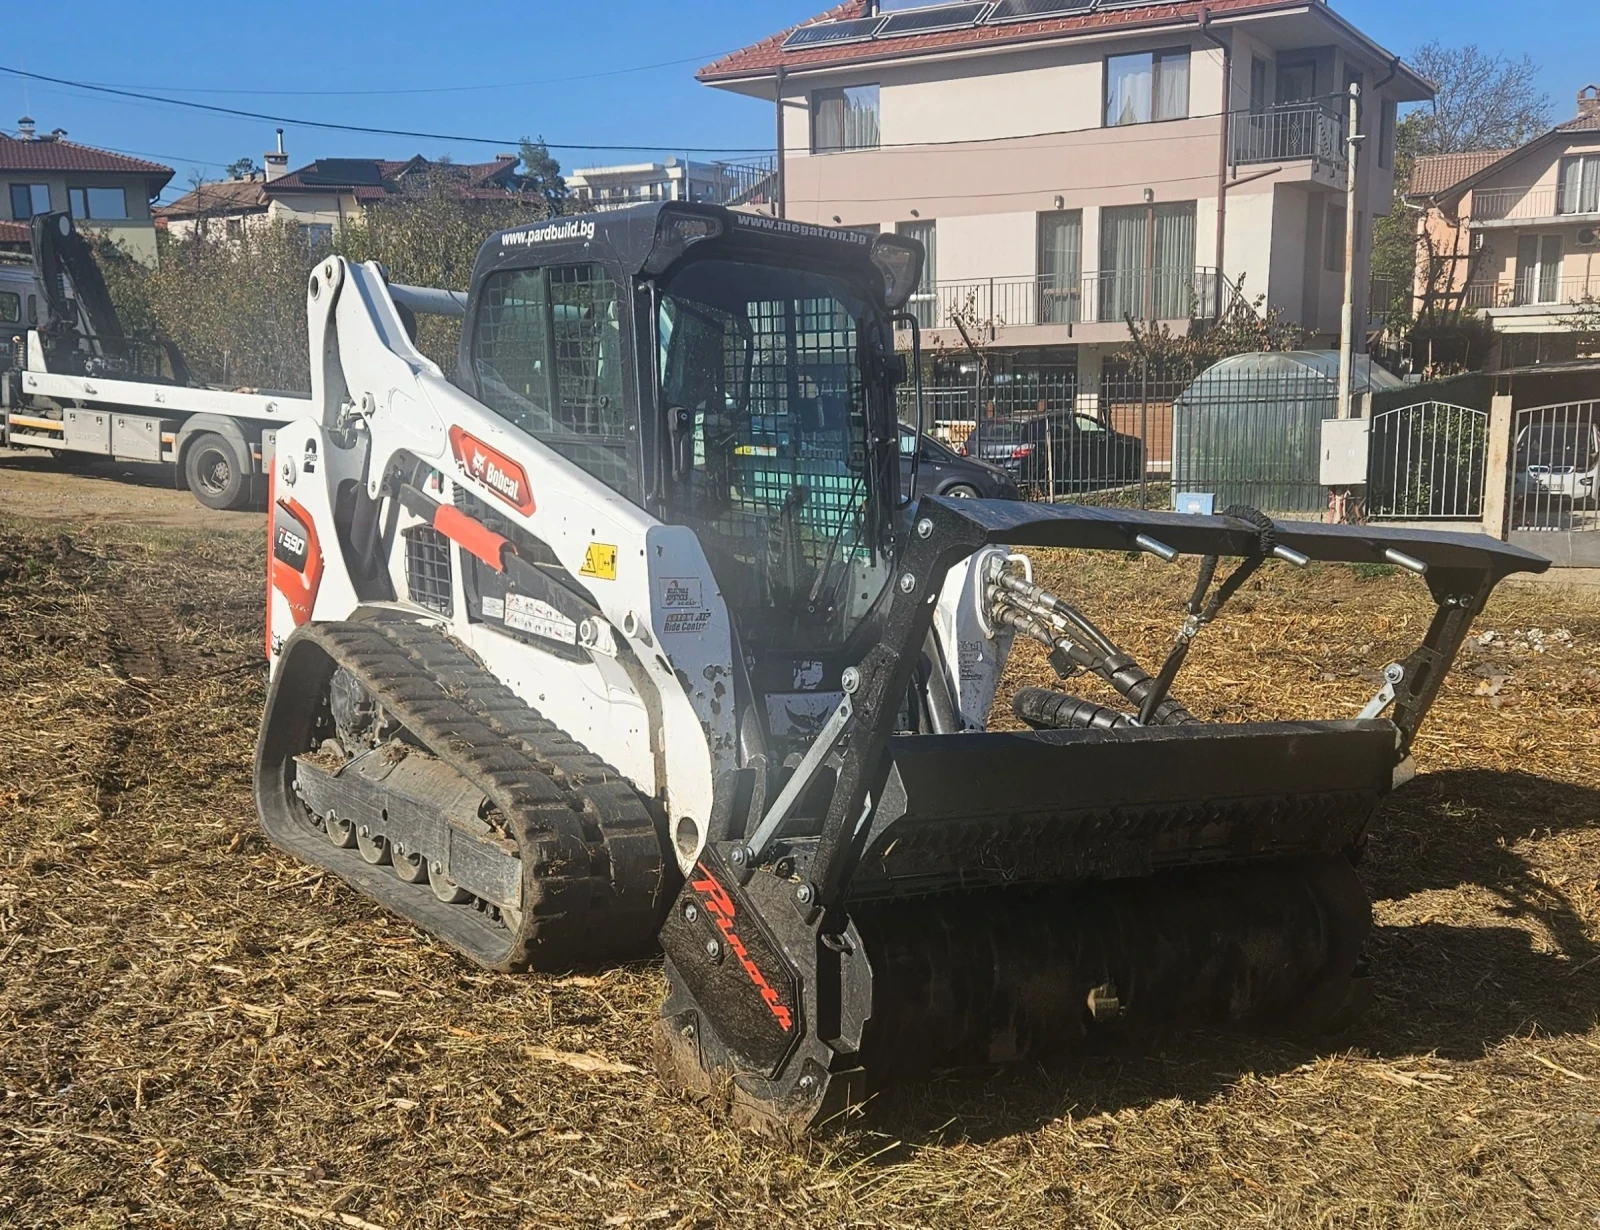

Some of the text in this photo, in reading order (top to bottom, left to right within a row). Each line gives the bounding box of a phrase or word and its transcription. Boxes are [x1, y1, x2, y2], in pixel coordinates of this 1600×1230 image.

[501, 219, 595, 247] www.pardbuild.bg
[737, 214, 867, 245] www.megatron.bg
[486, 461, 519, 500] Bobcat
[278, 527, 305, 556] T590
[664, 622, 681, 632] Ride
